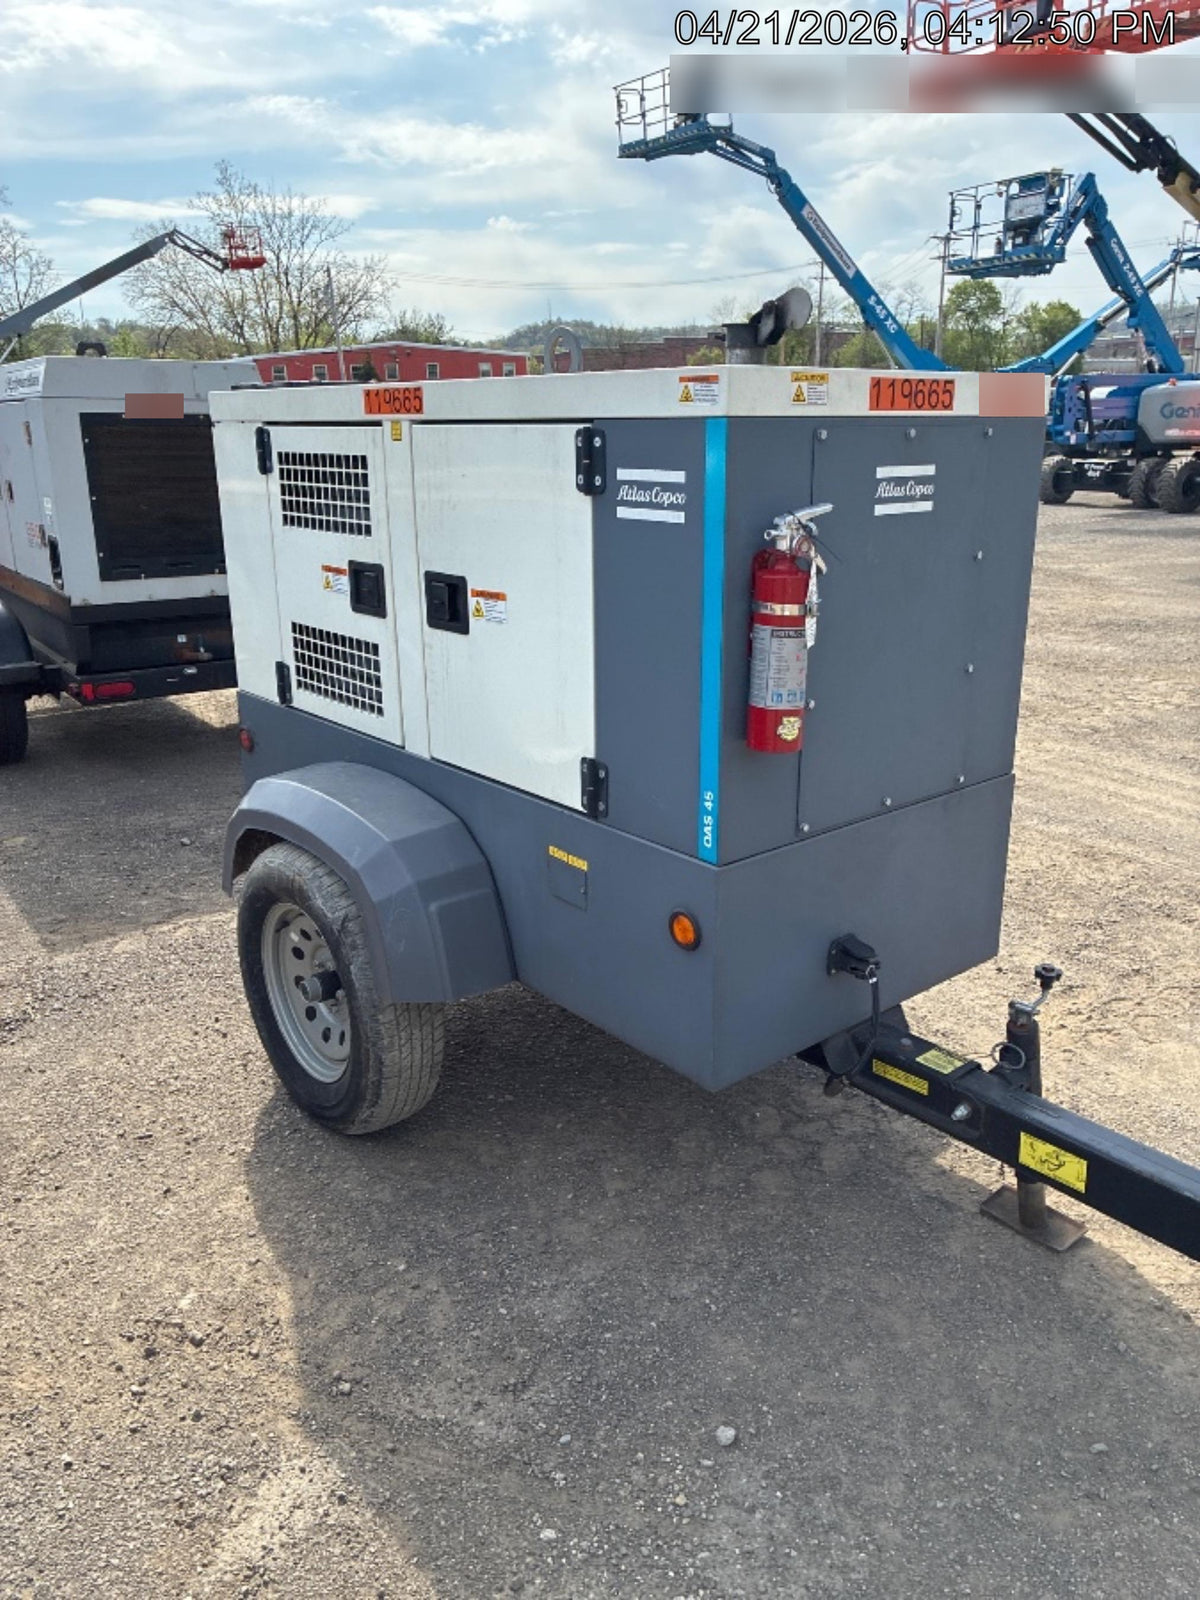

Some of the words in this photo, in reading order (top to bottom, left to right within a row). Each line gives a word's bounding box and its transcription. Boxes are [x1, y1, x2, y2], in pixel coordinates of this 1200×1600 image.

[364, 387, 423, 413] 119665
[872, 378, 955, 409] 119665
[617, 484, 651, 503] Atlas
[652, 486, 687, 507] Copco
[874, 480, 905, 498] Atlas
[905, 480, 935, 498] Copco
[703, 789, 714, 812] 45
